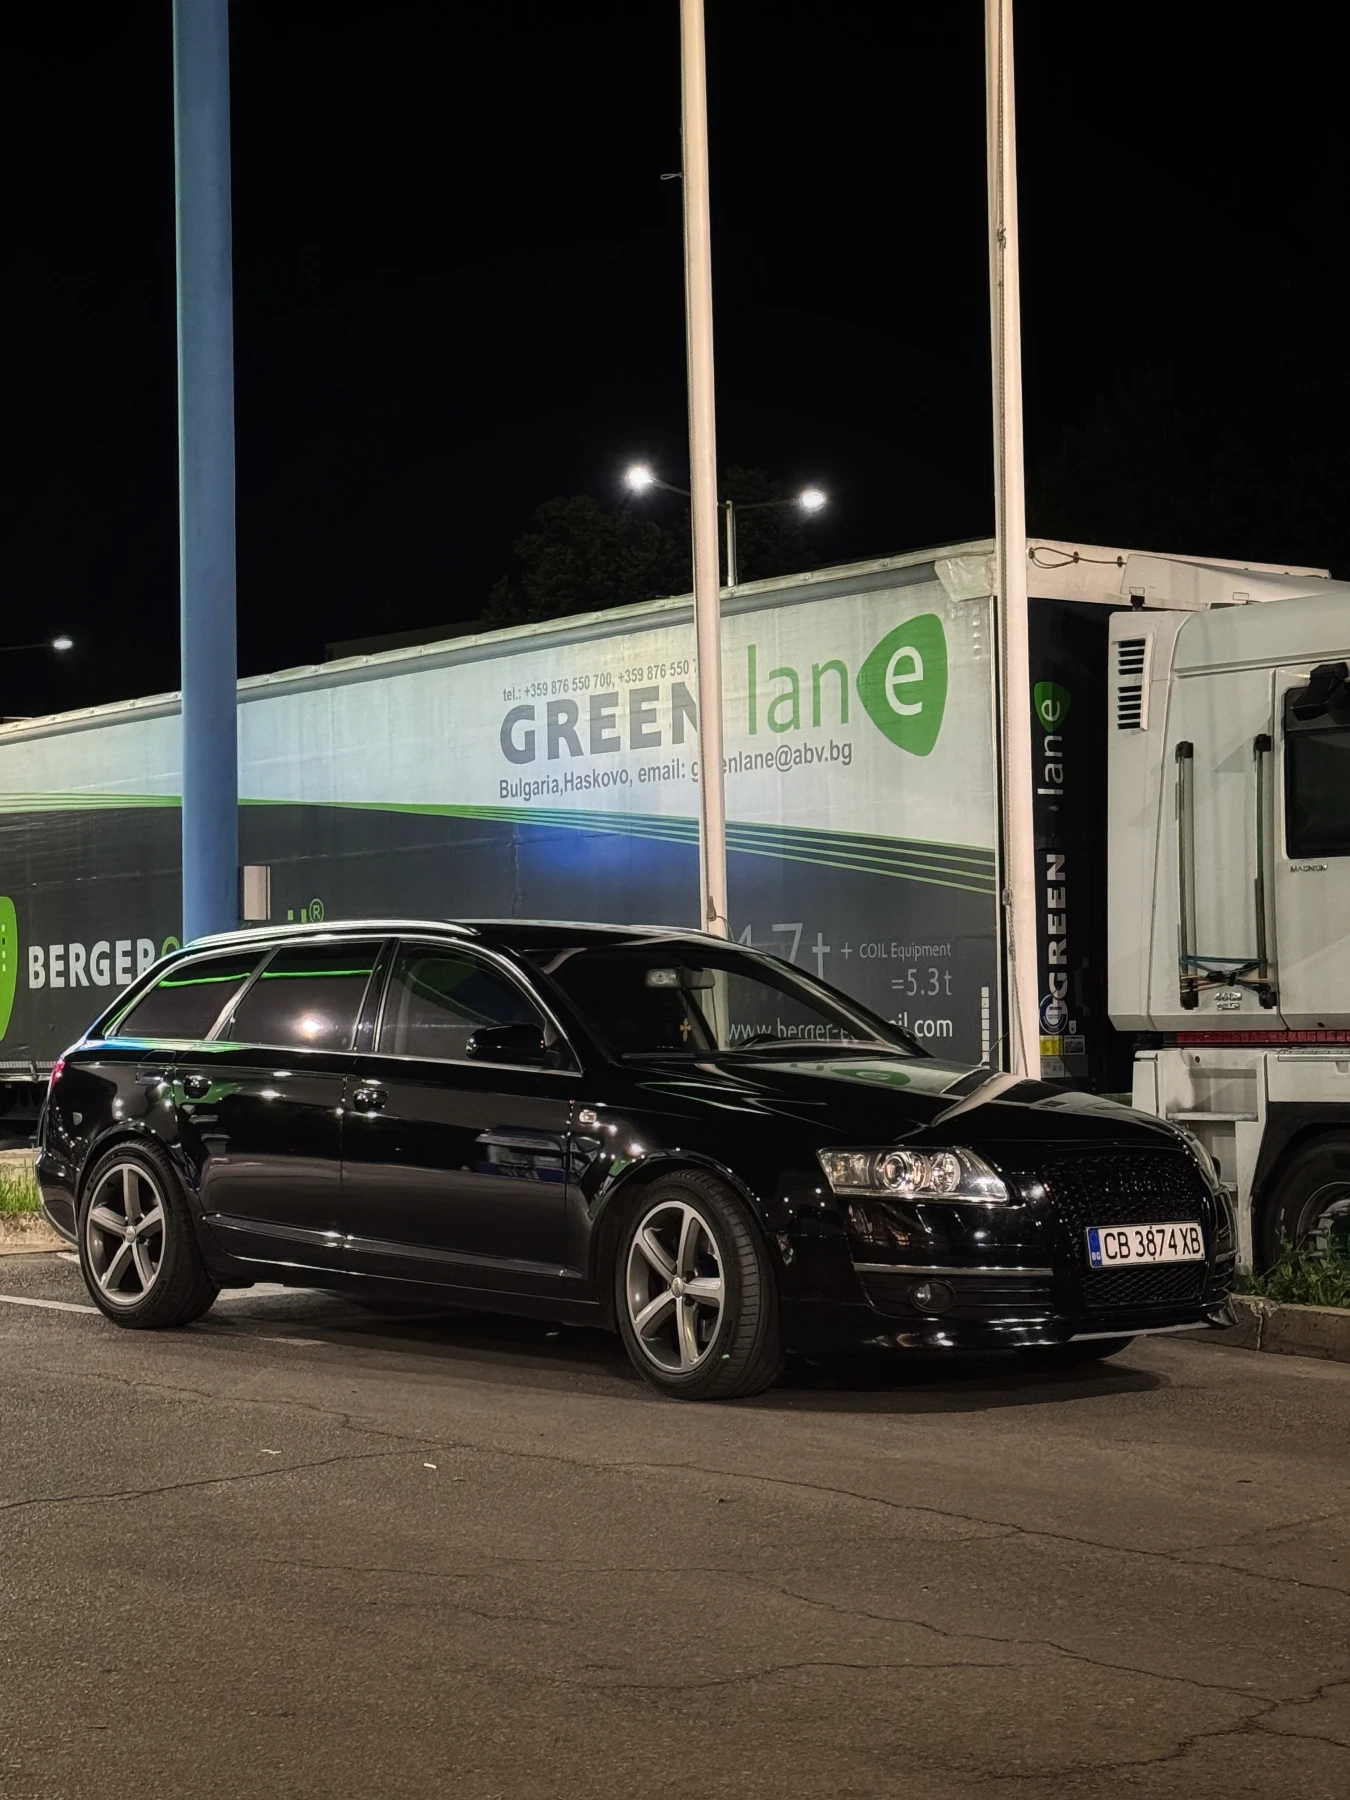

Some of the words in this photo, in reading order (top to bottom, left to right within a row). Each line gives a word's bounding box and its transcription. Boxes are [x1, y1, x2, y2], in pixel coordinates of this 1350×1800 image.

[503, 686, 522, 701] tel.:
[524, 682, 548, 698] +359
[551, 679, 569, 695] 876
[572, 675, 590, 692] 550
[593, 672, 615, 689] 700,
[618, 667, 644, 684] +359
[647, 663, 667, 680] 876
[669, 660, 690, 677] 550
[500, 682, 698, 765] GREEN
[638, 758, 686, 783] email:
[691, 739, 853, 783] genlane@abv.bg
[1046, 854, 1069, 999] GREEN
[860, 943, 889, 959] COIL
[891, 942, 952, 962] Equipment
[1092, 1252, 1101, 1261] BG
